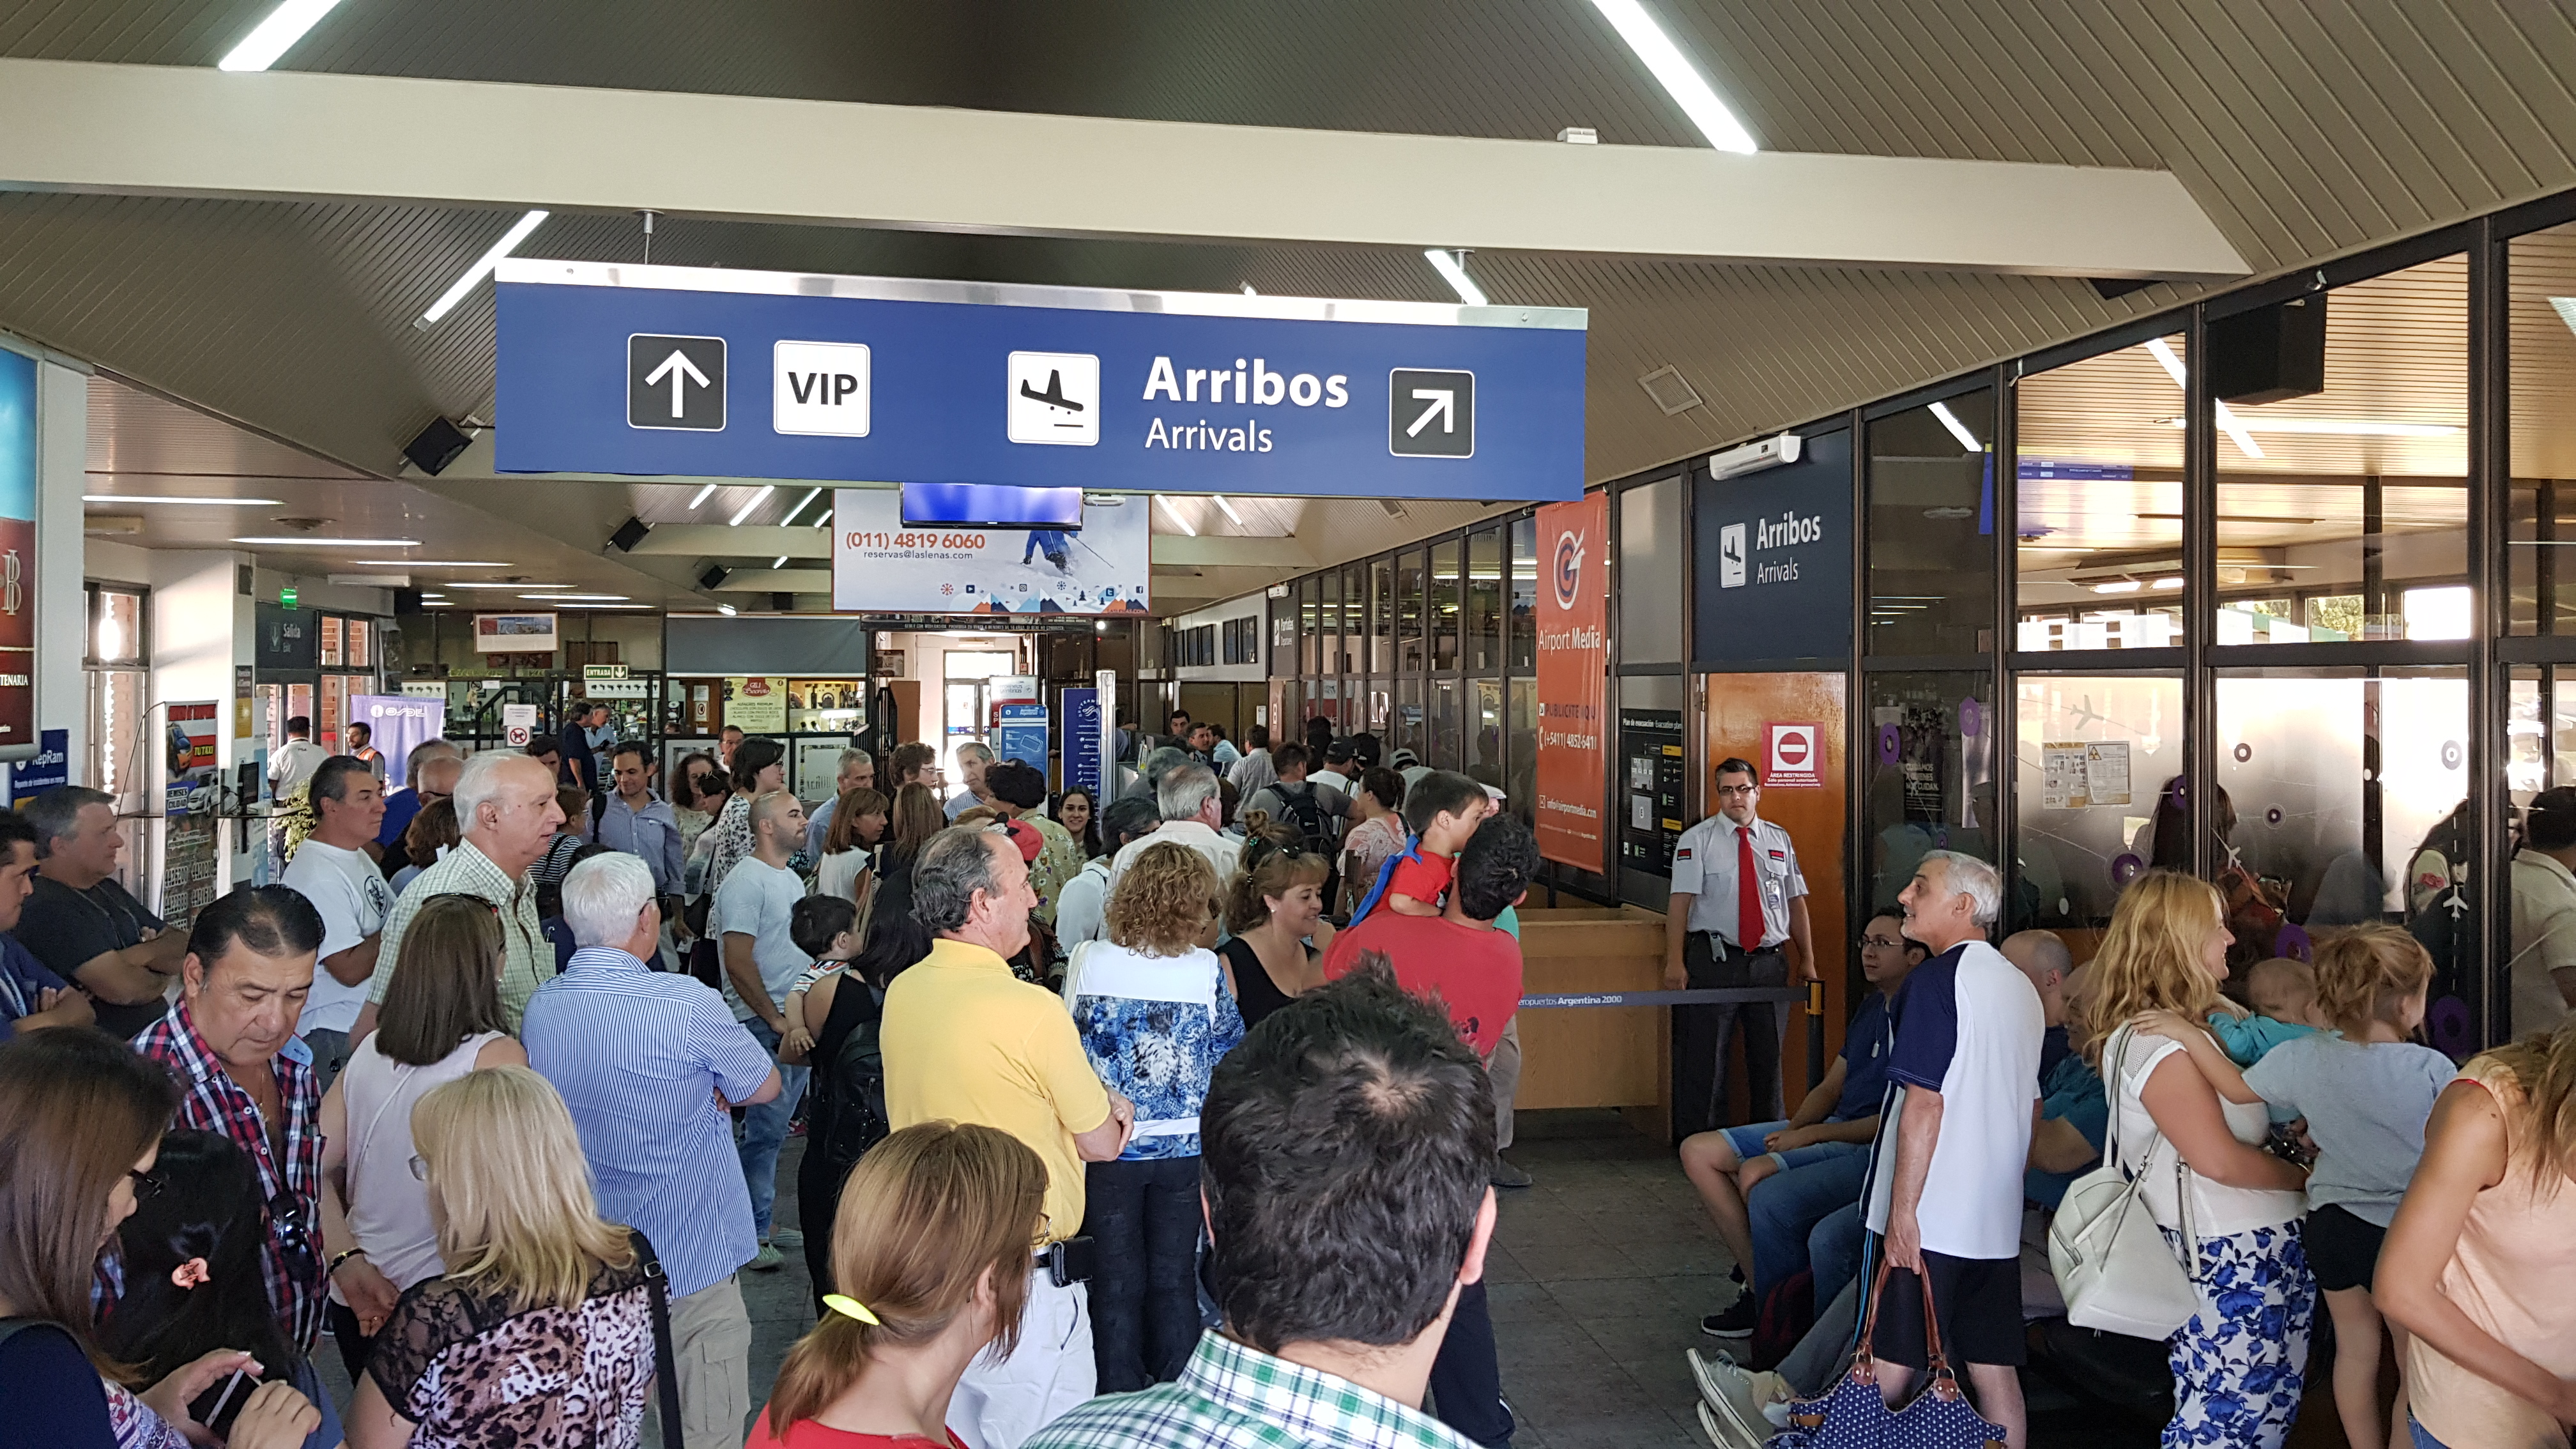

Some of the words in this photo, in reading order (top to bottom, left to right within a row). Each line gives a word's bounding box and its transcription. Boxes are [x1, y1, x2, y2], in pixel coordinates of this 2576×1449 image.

[788, 372, 858, 406] VIP
[1142, 355, 1349, 408] Arribos
[1144, 417, 1273, 452] Arrivals
[1757, 510, 1821, 550] Arribos
[846, 532, 889, 549] (011)
[894, 533, 938, 548] 4819
[942, 534, 985, 549] 6060
[864, 550, 973, 560] reservas@laslenas.com
[1757, 556, 1798, 584] Arrivals
[283, 623, 301, 638] Salida
[1538, 629, 1570, 656] Airport
[1572, 624, 1600, 650] Media
[1545, 703, 1579, 718] PUBLICITE
[1544, 730, 1565, 749] (+5411)
[167, 788, 188, 799] REMISES
[168, 799, 187, 809] CIUDAD
[1517, 997, 1557, 1006] eropuertos
[1557, 996, 1601, 1006] Argentina
[1602, 995, 1622, 1004] 2000
